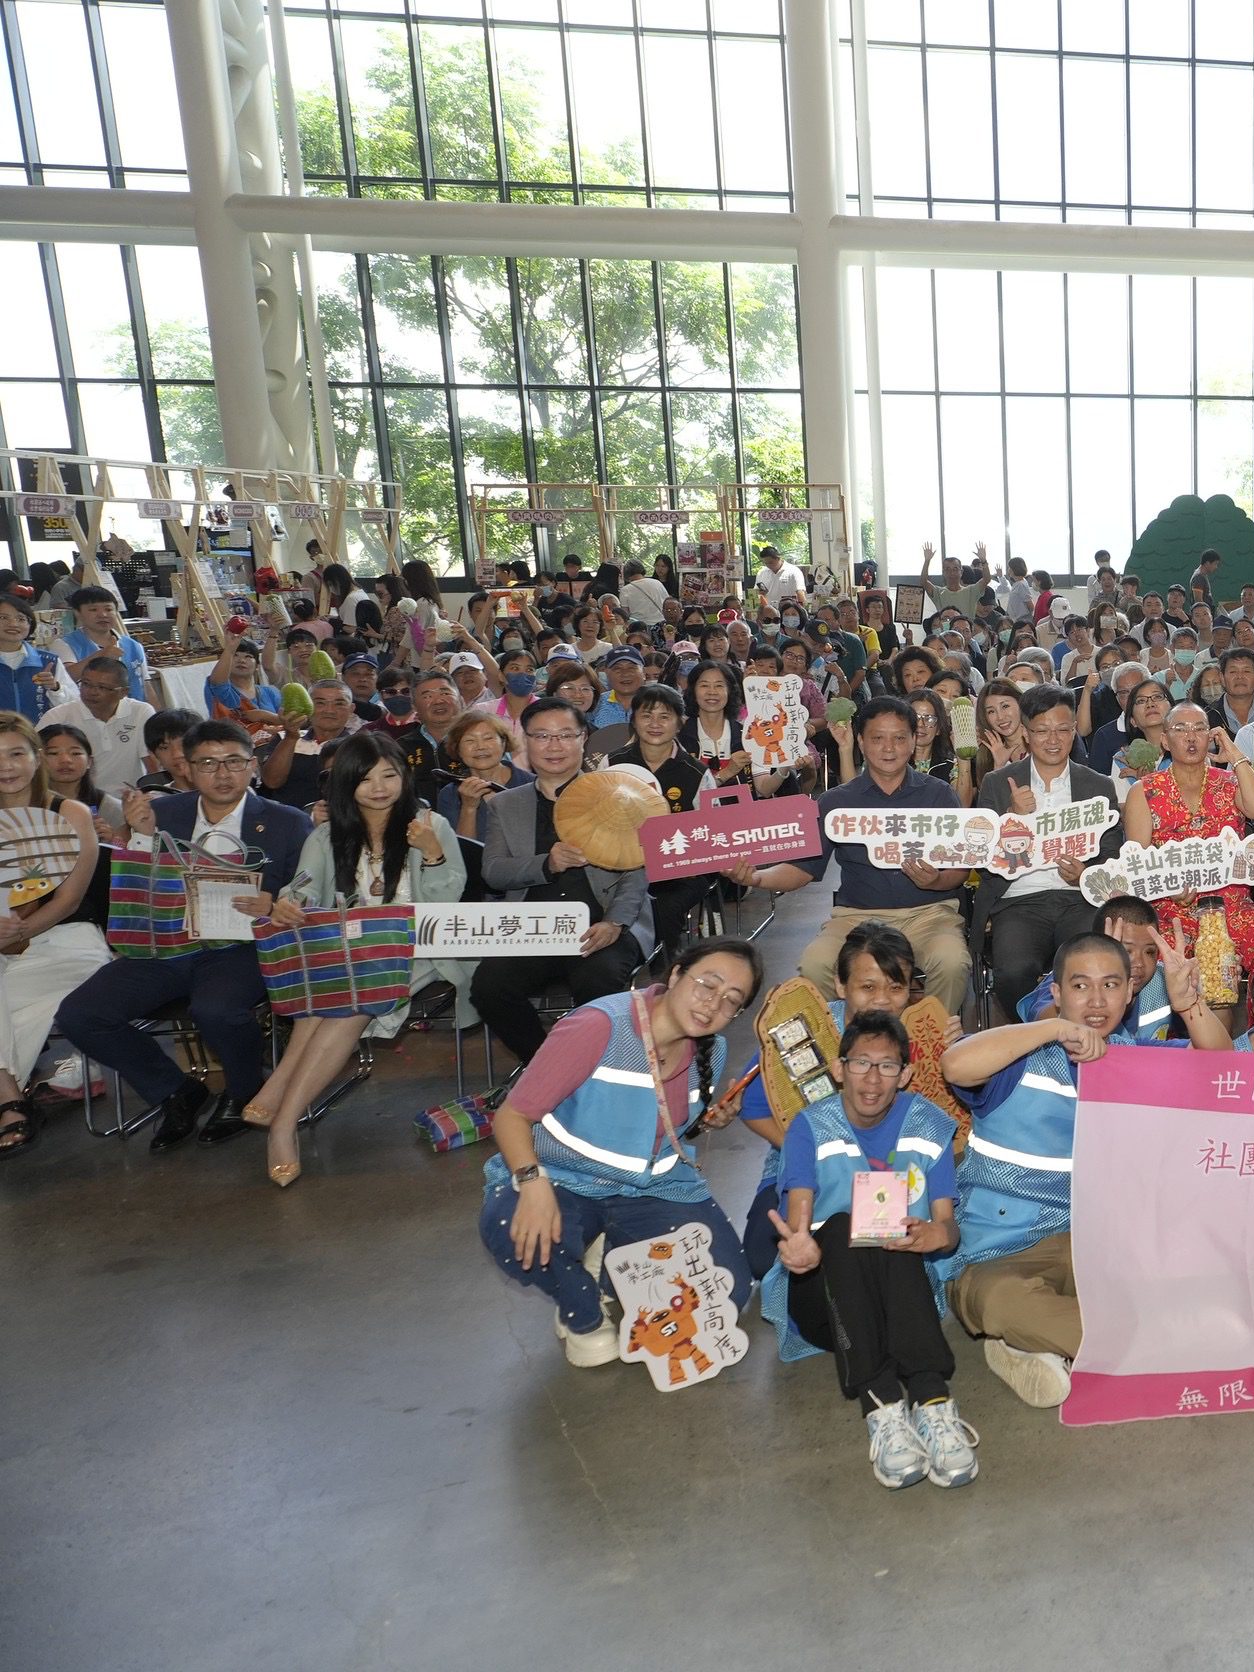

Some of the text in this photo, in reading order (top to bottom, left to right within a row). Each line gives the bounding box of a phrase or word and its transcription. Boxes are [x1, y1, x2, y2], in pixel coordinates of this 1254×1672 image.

[690, 822, 805, 848] 樹德 SHUTER
[831, 813, 960, 837] 作伙來市仔
[691, 855, 712, 865] always
[713, 853, 729, 861] there
[740, 850, 752, 858] you
[874, 842, 925, 865] 喝茶
[1041, 832, 1096, 864] 覺醒！
[1131, 867, 1230, 898] 買菜也潮派！
[444, 914, 577, 937] 半山夢工廠
[679, 1229, 742, 1360] 玩出新高度
